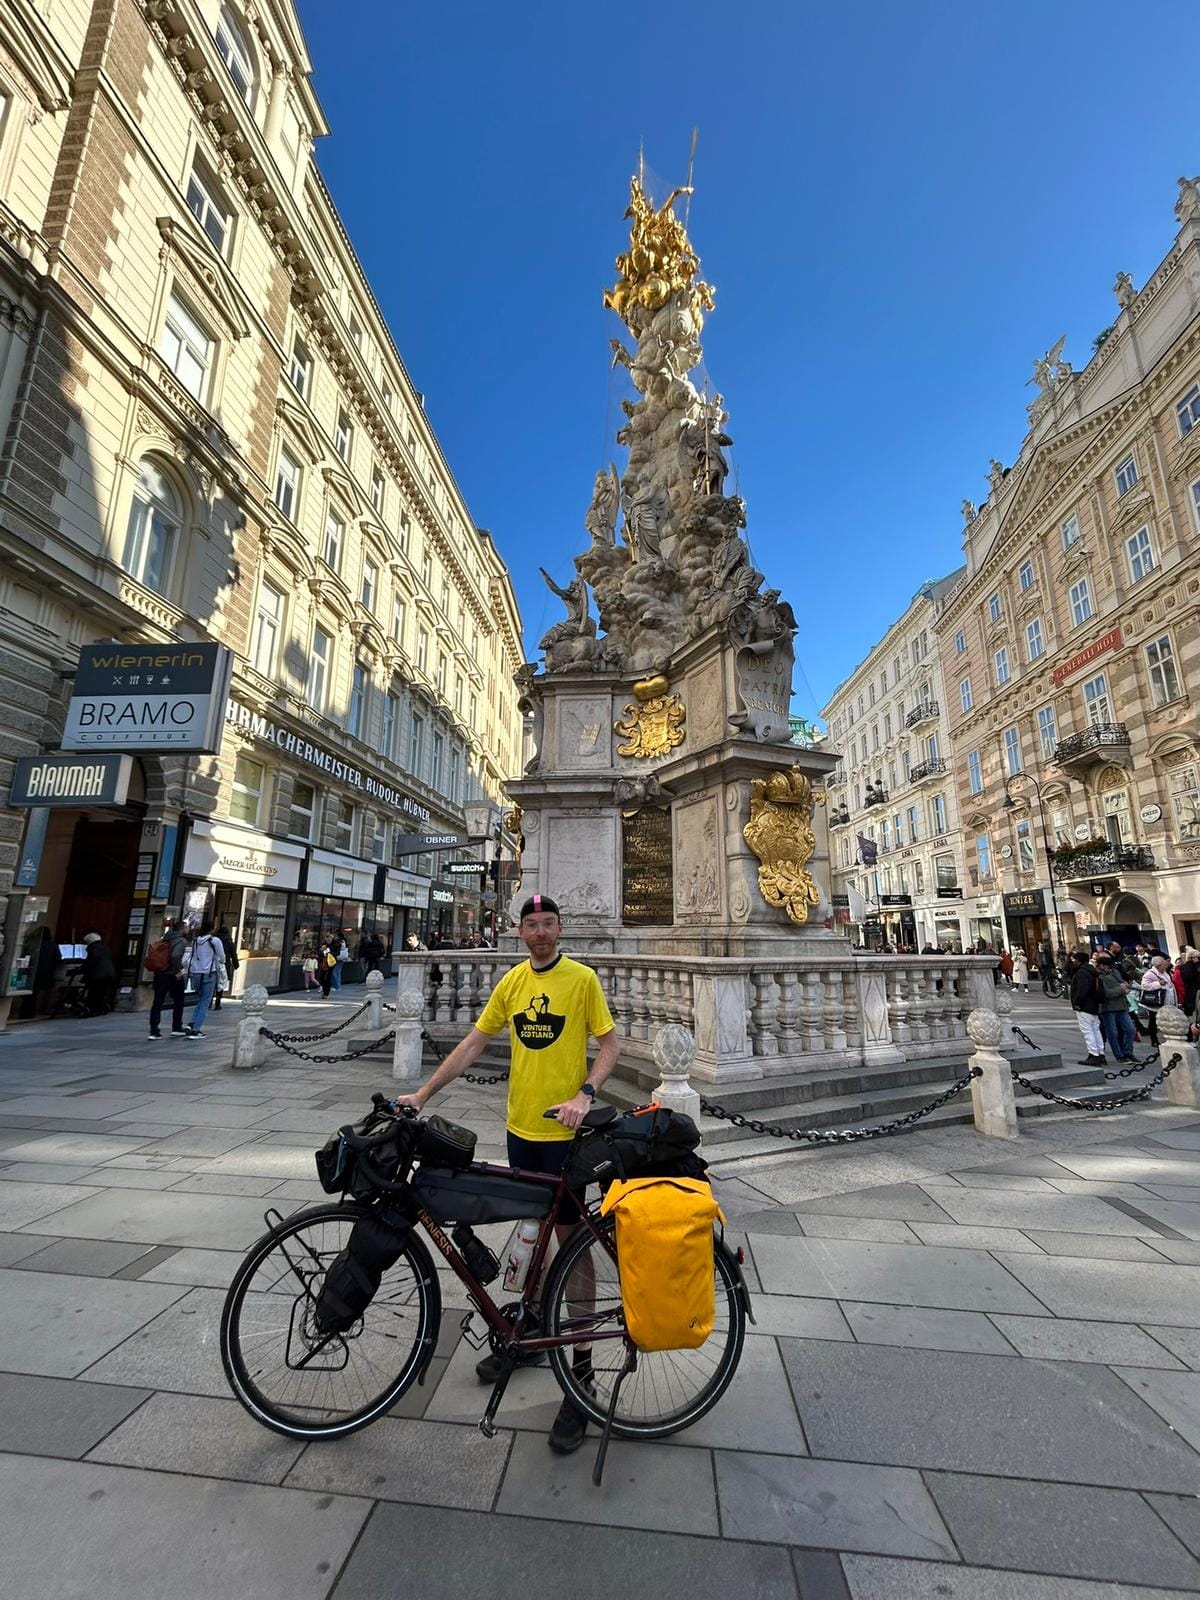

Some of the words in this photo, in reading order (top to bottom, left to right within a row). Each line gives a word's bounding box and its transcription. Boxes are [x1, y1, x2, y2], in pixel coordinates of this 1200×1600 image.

[1096, 633, 1117, 652] HOF
[92, 652, 203, 668] wienerin
[747, 655, 784, 675] DEO
[79, 701, 195, 726] BRAMO
[81, 733, 187, 741] COIFFEUR
[225, 698, 361, 788] HRMACHERMEISTER
[403, 797, 430, 822] HÜBNER
[451, 864, 480, 872] swatch
[1009, 895, 1034, 905] KNIZE
[520, 1031, 554, 1039] SCOTLAND
[522, 1024, 552, 1032] VENTURE
[417, 1208, 453, 1256] GENESIS
